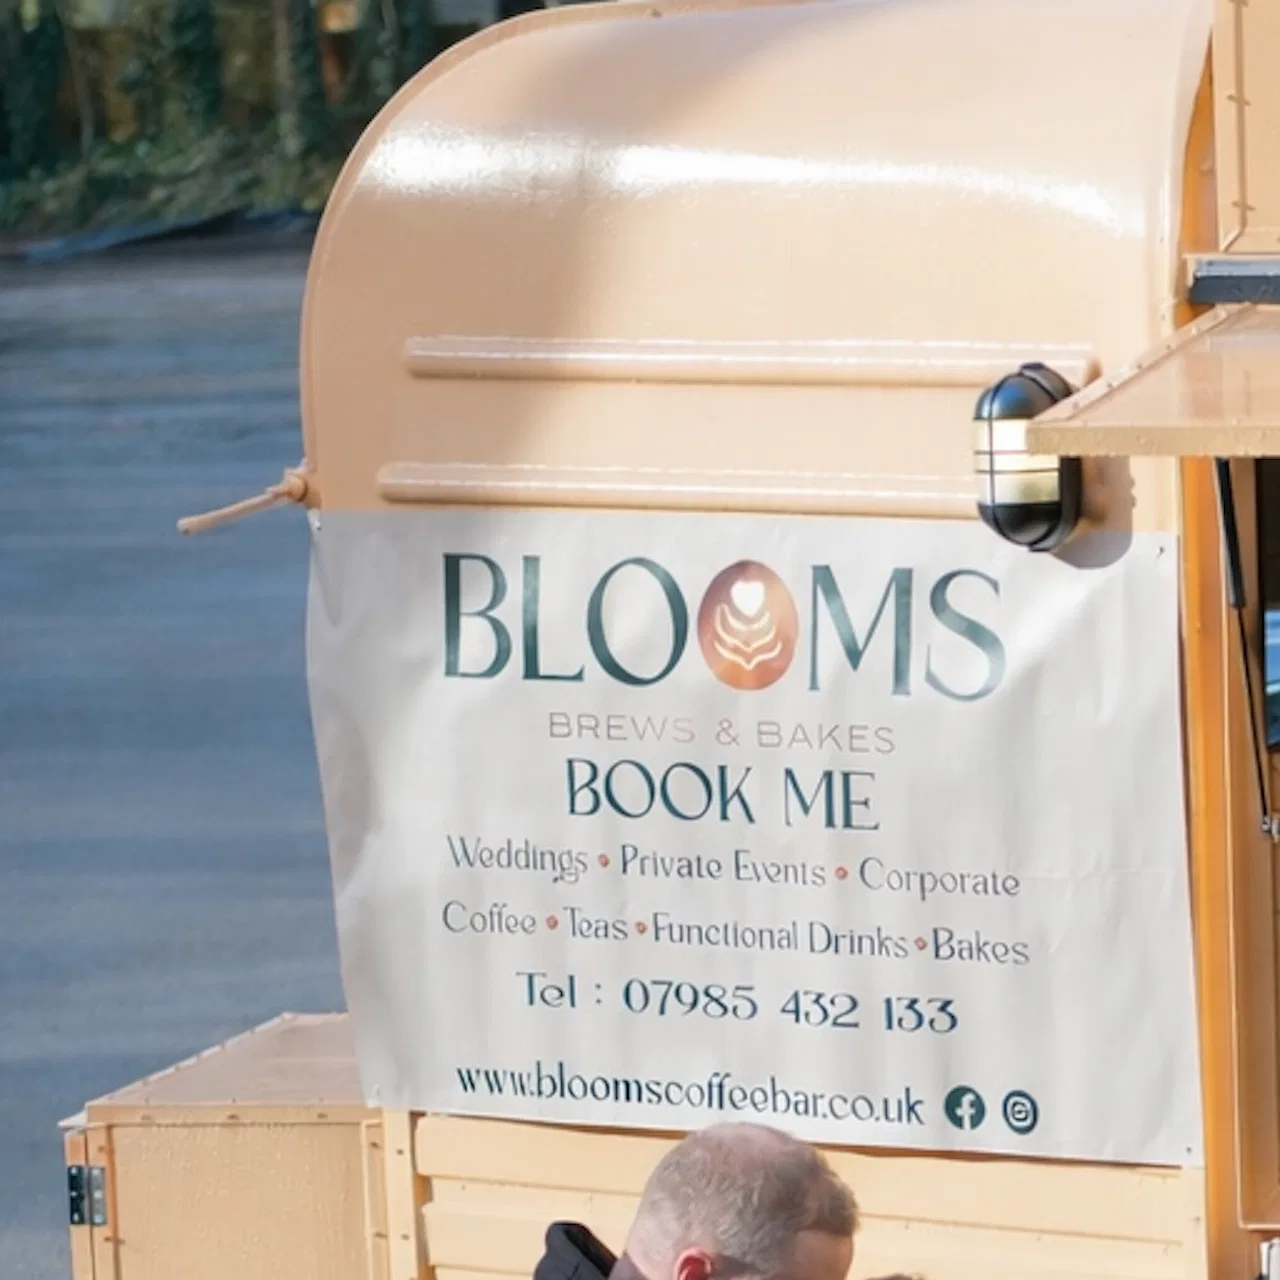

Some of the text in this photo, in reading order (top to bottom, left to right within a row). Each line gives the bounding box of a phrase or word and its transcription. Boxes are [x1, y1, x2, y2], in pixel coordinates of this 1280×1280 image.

[442, 551, 1006, 703] BLOOMS
[547, 711, 896, 755] BREWS & BAKES
[565, 757, 881, 832] BOOK ME
[445, 834, 1021, 902] Weddings Private Events Corporate
[442, 899, 1031, 967] Coffee Teas Functional Drinks Bakes
[515, 971, 578, 1009] Tel
[622, 976, 760, 1021] 07985
[779, 988, 861, 1030] 432
[884, 995, 960, 1034] 133
[455, 1059, 926, 1126] www.bloomscoffeebar.co.uk
